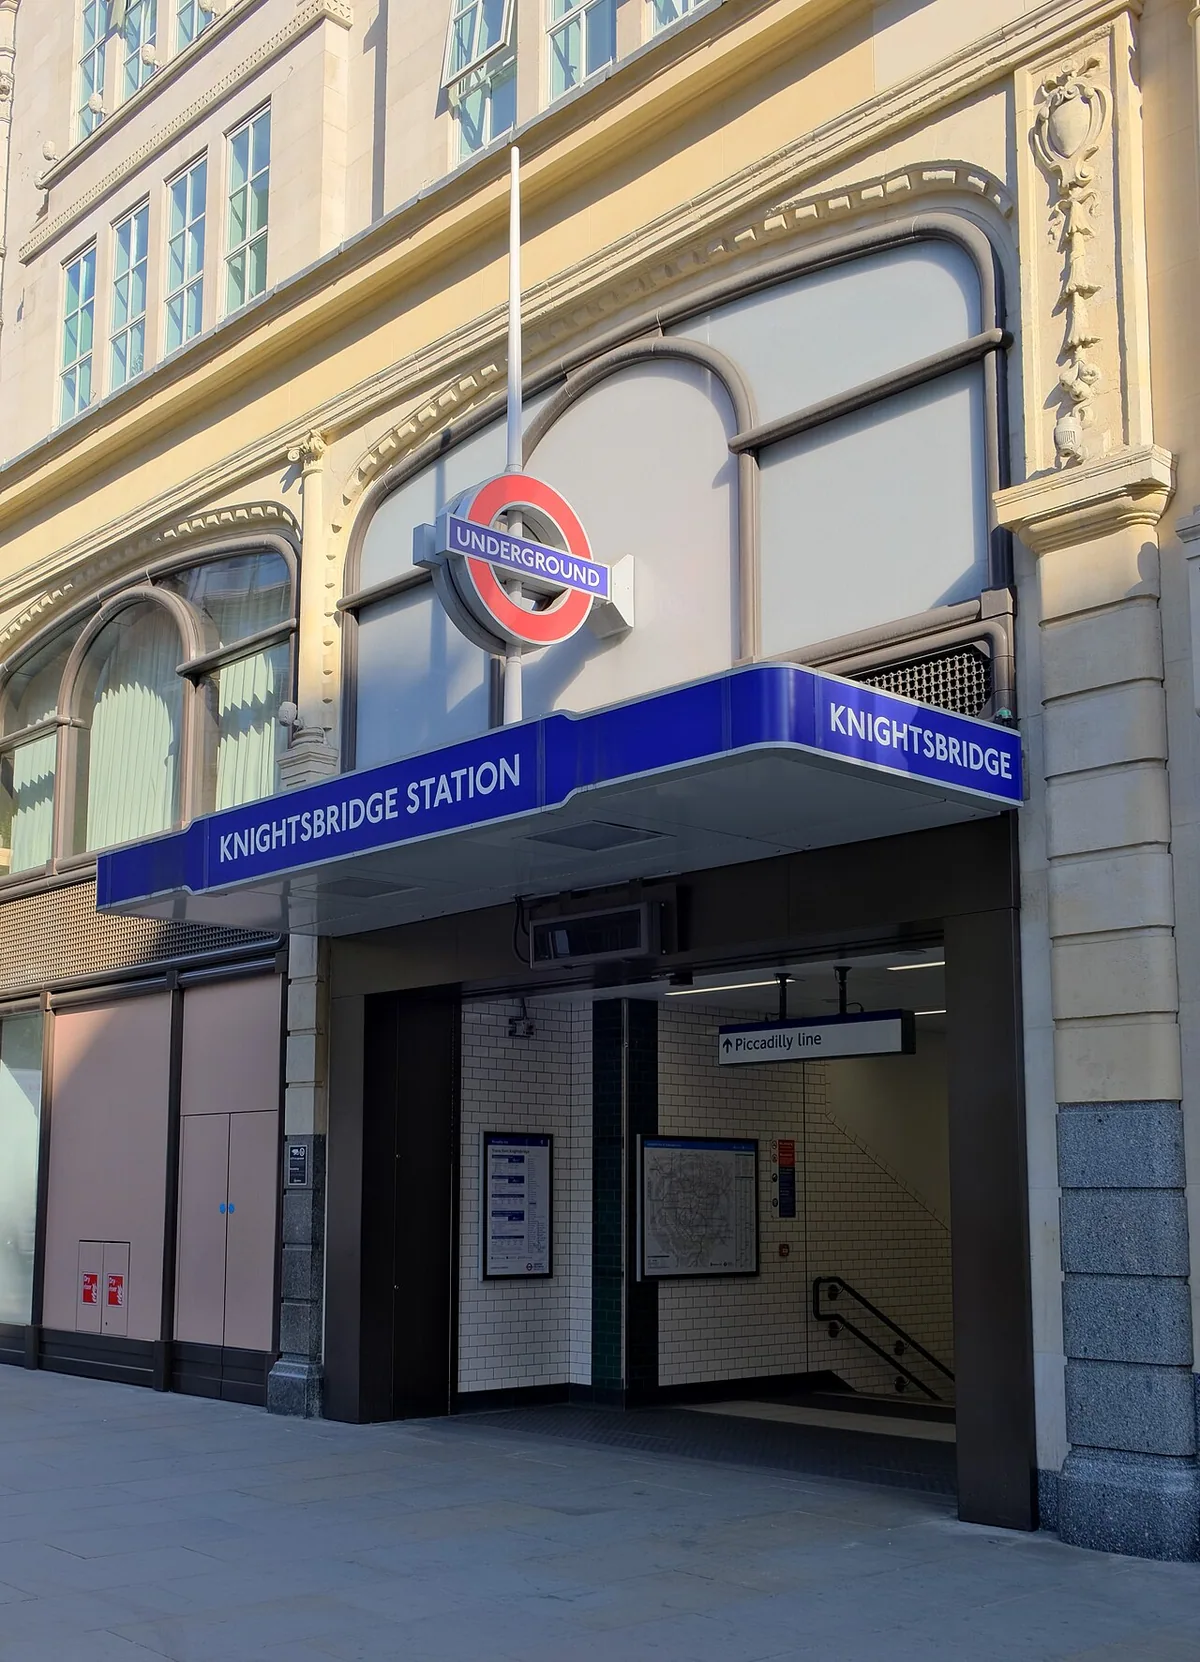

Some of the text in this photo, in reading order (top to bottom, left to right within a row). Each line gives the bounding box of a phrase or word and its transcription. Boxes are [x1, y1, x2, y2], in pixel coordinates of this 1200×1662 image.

[456, 526, 600, 587] UNDERGROUND
[830, 702, 1012, 779] KNIGHTSBRIDGE
[220, 753, 520, 863] KNIGHTSBRIDGE STATION
[735, 1033, 822, 1051] Piccadilly line
